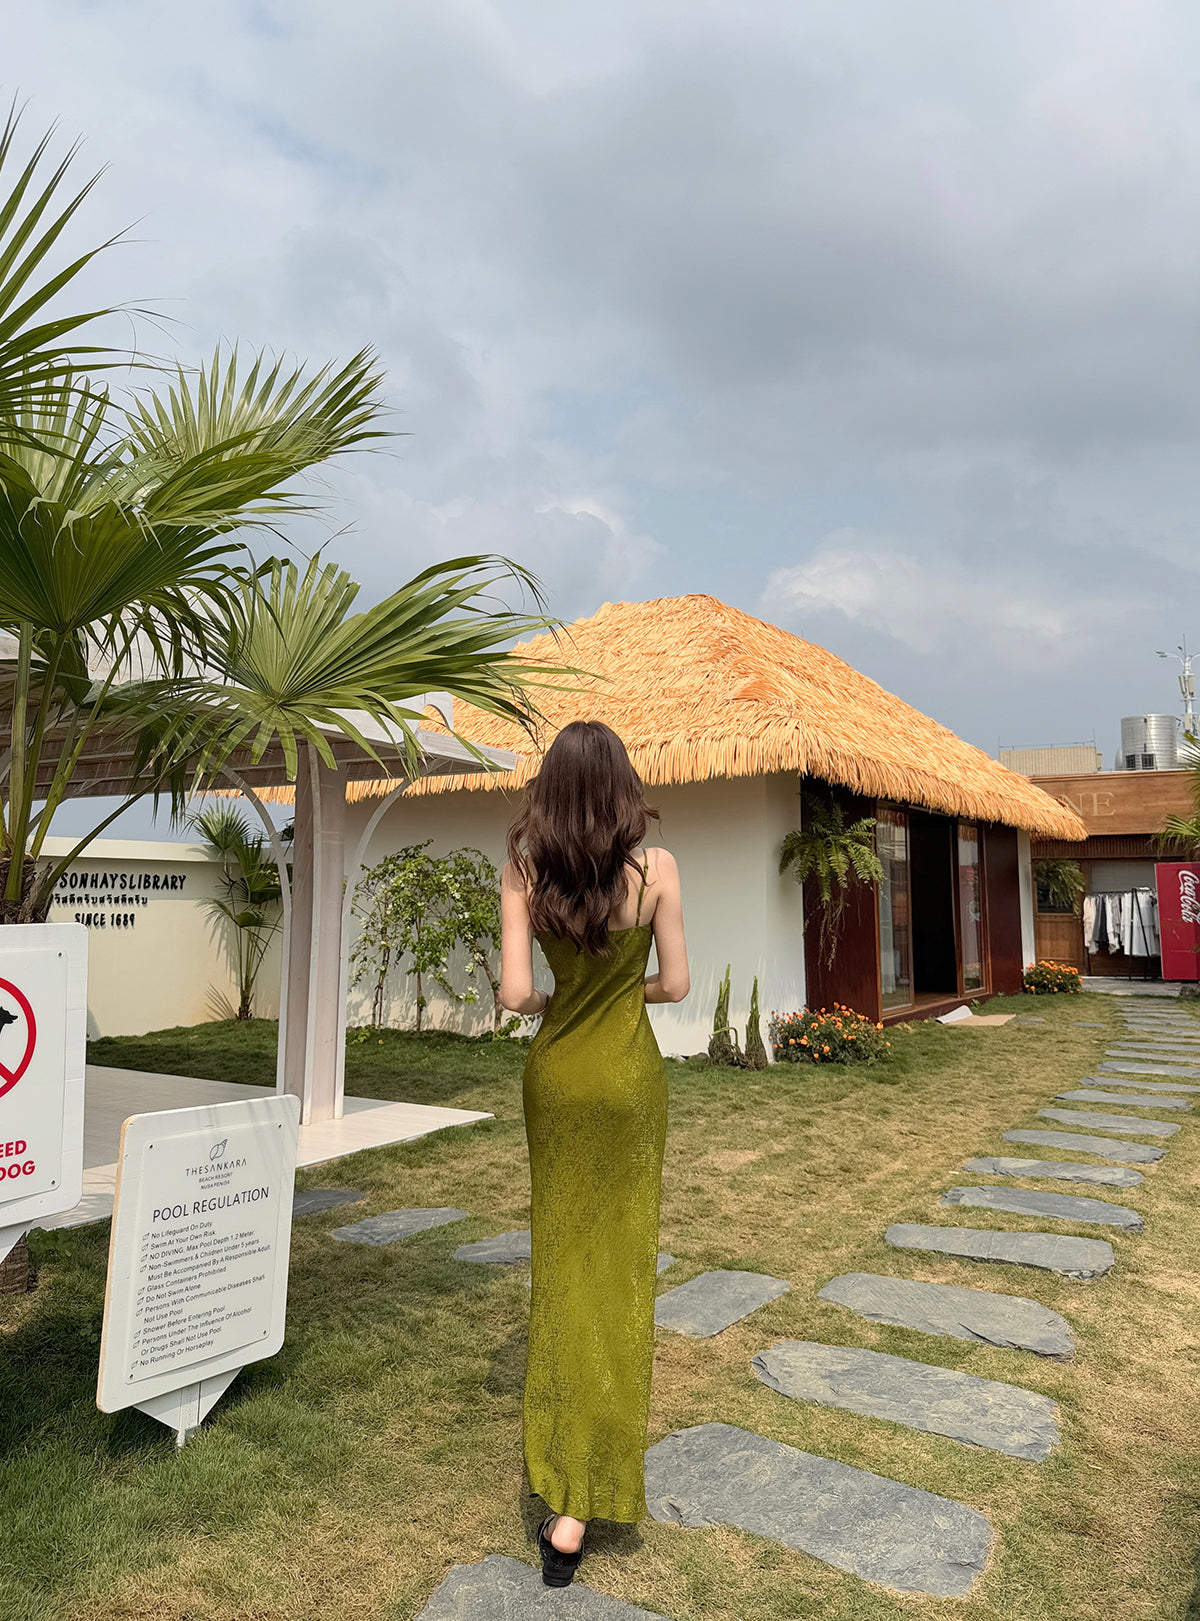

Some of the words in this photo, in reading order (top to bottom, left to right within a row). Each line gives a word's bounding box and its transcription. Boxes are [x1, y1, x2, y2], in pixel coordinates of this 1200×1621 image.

[56, 872, 187, 890] SONHAYSLIBRARY
[52, 893, 148, 905] วัสดีครับสวัสดีครับ
[75, 913, 106, 926] SINCE
[111, 913, 135, 926] 1689
[215, 1172, 233, 1180] RESORT
[153, 1203, 189, 1222] POOL
[193, 1187, 269, 1214] REGULATION
[161, 1226, 189, 1237] Lifeguard
[200, 1221, 213, 1229] Duty
[149, 1256, 193, 1271] Non-Swimmers
[200, 1248, 223, 1258] Children
[224, 1244, 240, 1252] Under
[244, 1239, 259, 1248] years
[150, 1252, 160, 1260] NO
[199, 1240, 212, 1248] Pool
[213, 1236, 229, 1245] Depth
[151, 1242, 167, 1250] Swim
[148, 1272, 163, 1281] Must
[173, 1260, 211, 1275] Accompanied
[212, 1258, 219, 1266] By
[225, 1249, 257, 1261] Responsible
[257, 1244, 270, 1253] Adult
[147, 1283, 165, 1292] Glass
[166, 1275, 197, 1287] Containers
[198, 1266, 226, 1278] Prohibited
[145, 1302, 170, 1313] Persons
[171, 1298, 185, 1306] With
[186, 1286, 226, 1302] Communicable
[227, 1279, 251, 1291] Diseases
[252, 1274, 265, 1283] Shall
[156, 1292, 167, 1300] Not
[168, 1288, 184, 1297] Swim
[185, 1284, 201, 1292] Alone
[142, 1334, 167, 1345] Persons
[169, 1327, 187, 1338] Under
[200, 1316, 224, 1328] Influence
[225, 1312, 232, 1320] Of
[232, 1306, 252, 1317] Alcohol
[143, 1323, 166, 1335] Shower
[167, 1318, 187, 1328] Before
[188, 1310, 212, 1321] Entering
[213, 1305, 225, 1314] Pool
[144, 1316, 155, 1324] Not
[156, 1313, 168, 1321] Use
[169, 1308, 183, 1316] Pool
[141, 1348, 149, 1356] Or
[150, 1344, 169, 1353] Drugs
[169, 1338, 185, 1348] Shall
[186, 1334, 196, 1342] Not
[197, 1331, 208, 1339] Use
[209, 1326, 222, 1335] Pool
[150, 1351, 176, 1363] Running
[185, 1339, 214, 1353] Horseplay
